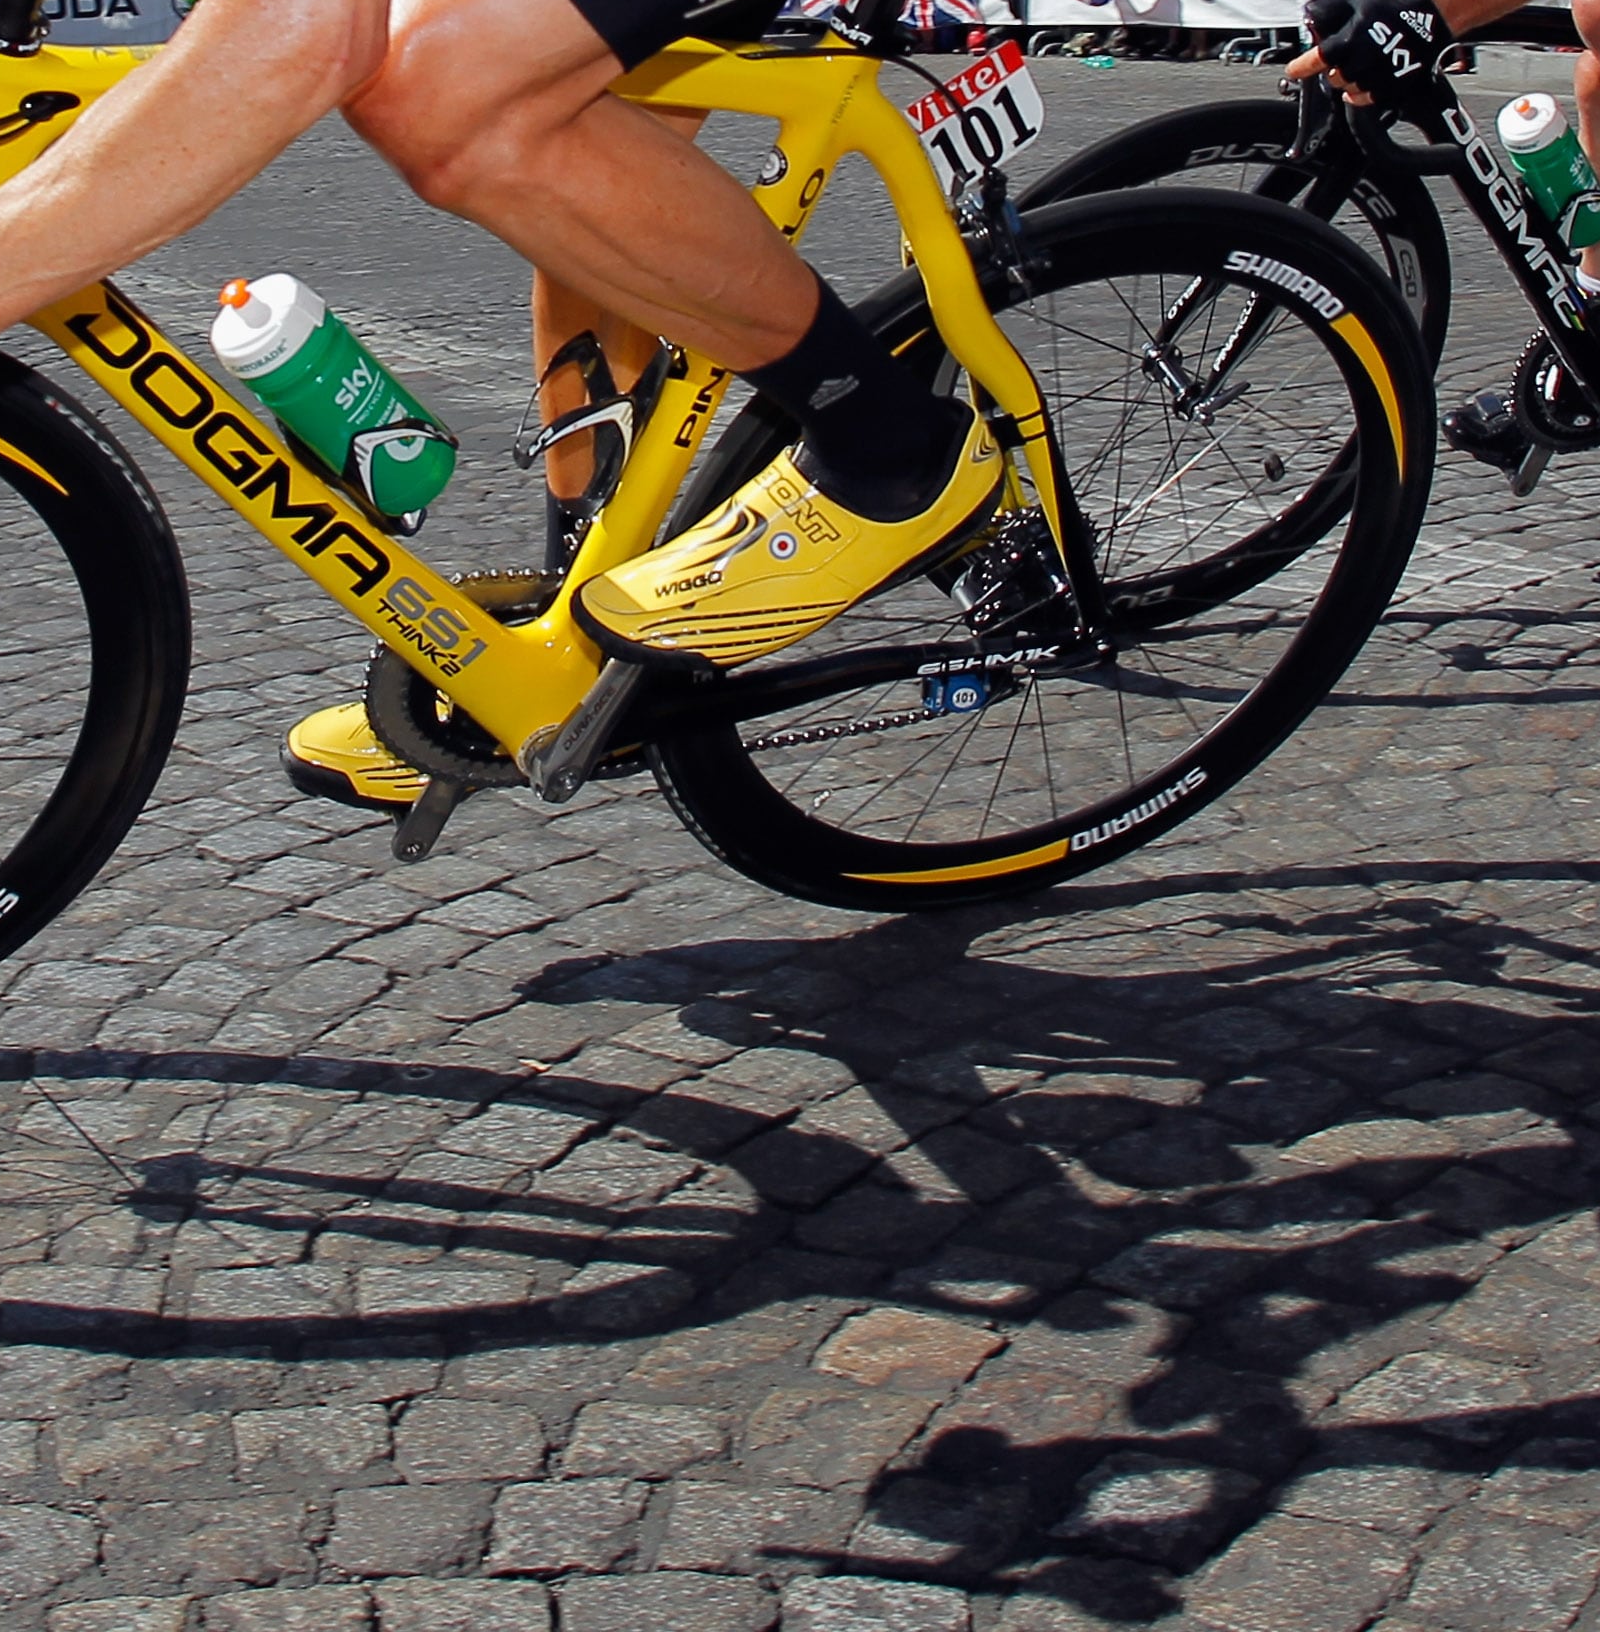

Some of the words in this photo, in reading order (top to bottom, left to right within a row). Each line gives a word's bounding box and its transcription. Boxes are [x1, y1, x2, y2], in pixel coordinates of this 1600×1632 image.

[1368, 20, 1422, 79] sky
[930, 85, 1038, 183] 101
[1441, 100, 1571, 301] DOGMA
[1222, 250, 1346, 320] SHIMANO
[334, 356, 374, 411] sky
[64, 291, 392, 598] DOGMA
[654, 570, 723, 599] WIGGO
[955, 690, 976, 705] 101
[1070, 768, 1209, 853] SHIMANO
